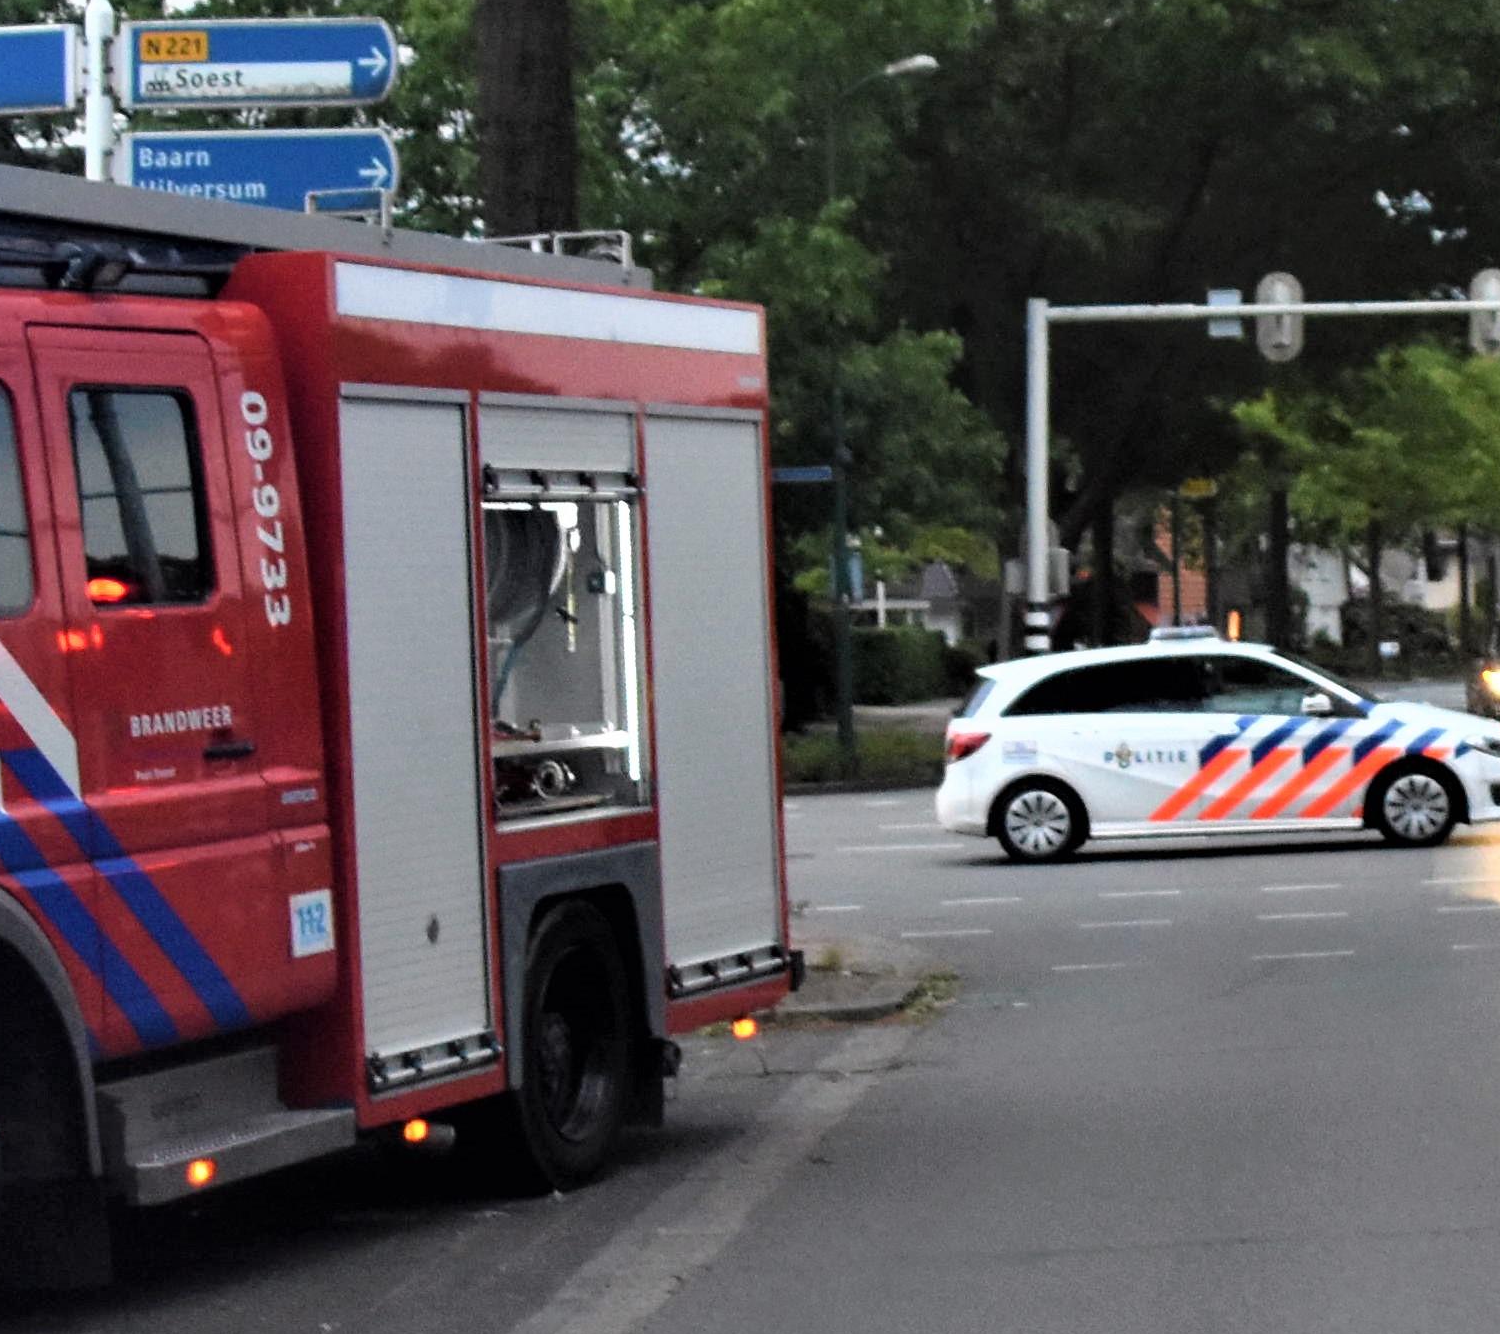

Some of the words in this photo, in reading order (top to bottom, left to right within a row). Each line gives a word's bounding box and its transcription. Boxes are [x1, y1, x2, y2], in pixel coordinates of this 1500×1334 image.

[176, 68, 244, 89] Soest
[138, 147, 210, 168] Baarn
[240, 390, 292, 627] 09-9733
[130, 705, 233, 738] BRANDWEER
